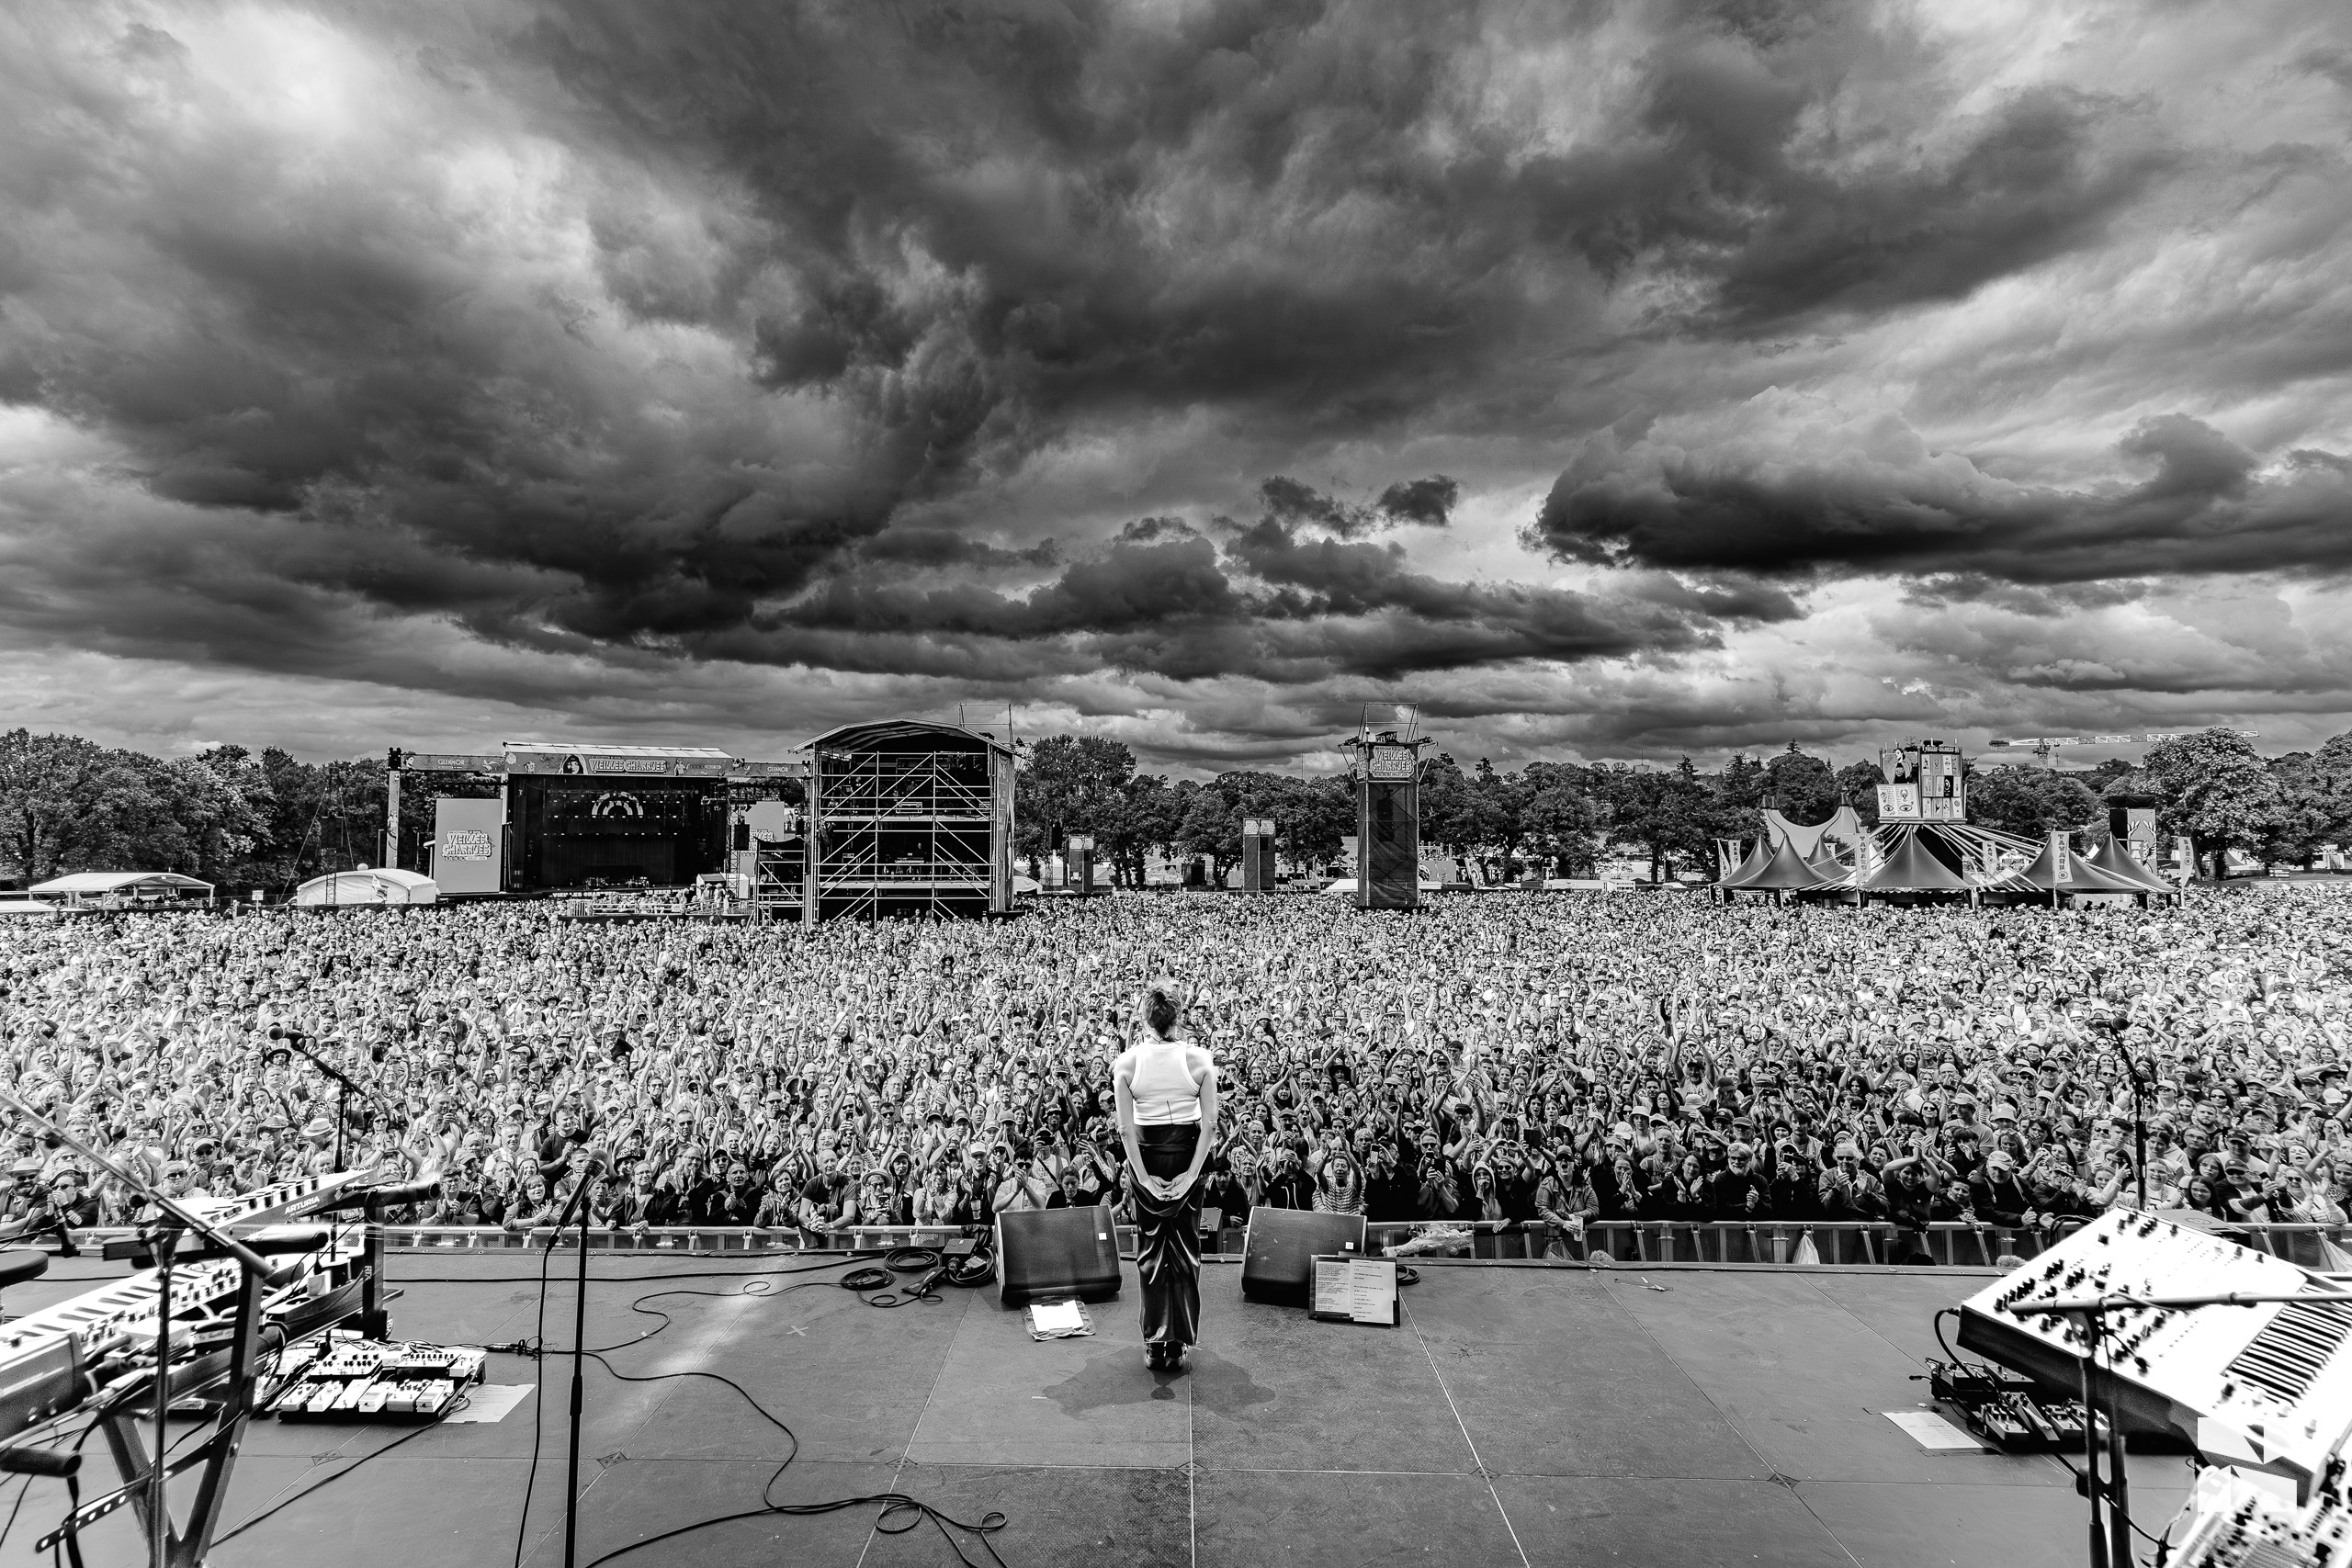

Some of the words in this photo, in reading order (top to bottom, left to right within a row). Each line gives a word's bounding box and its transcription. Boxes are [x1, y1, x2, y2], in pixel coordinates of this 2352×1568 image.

[1374, 750, 1409, 761] VIEILLES
[589, 758, 625, 772] VIEILLES
[625, 759, 667, 773] CHARRUES
[446, 833, 490, 844] VIEILLES
[441, 843, 492, 856] CHARRUES
[2183, 839, 2191, 857] BAR
[285, 1195, 321, 1214] ARTURIA
